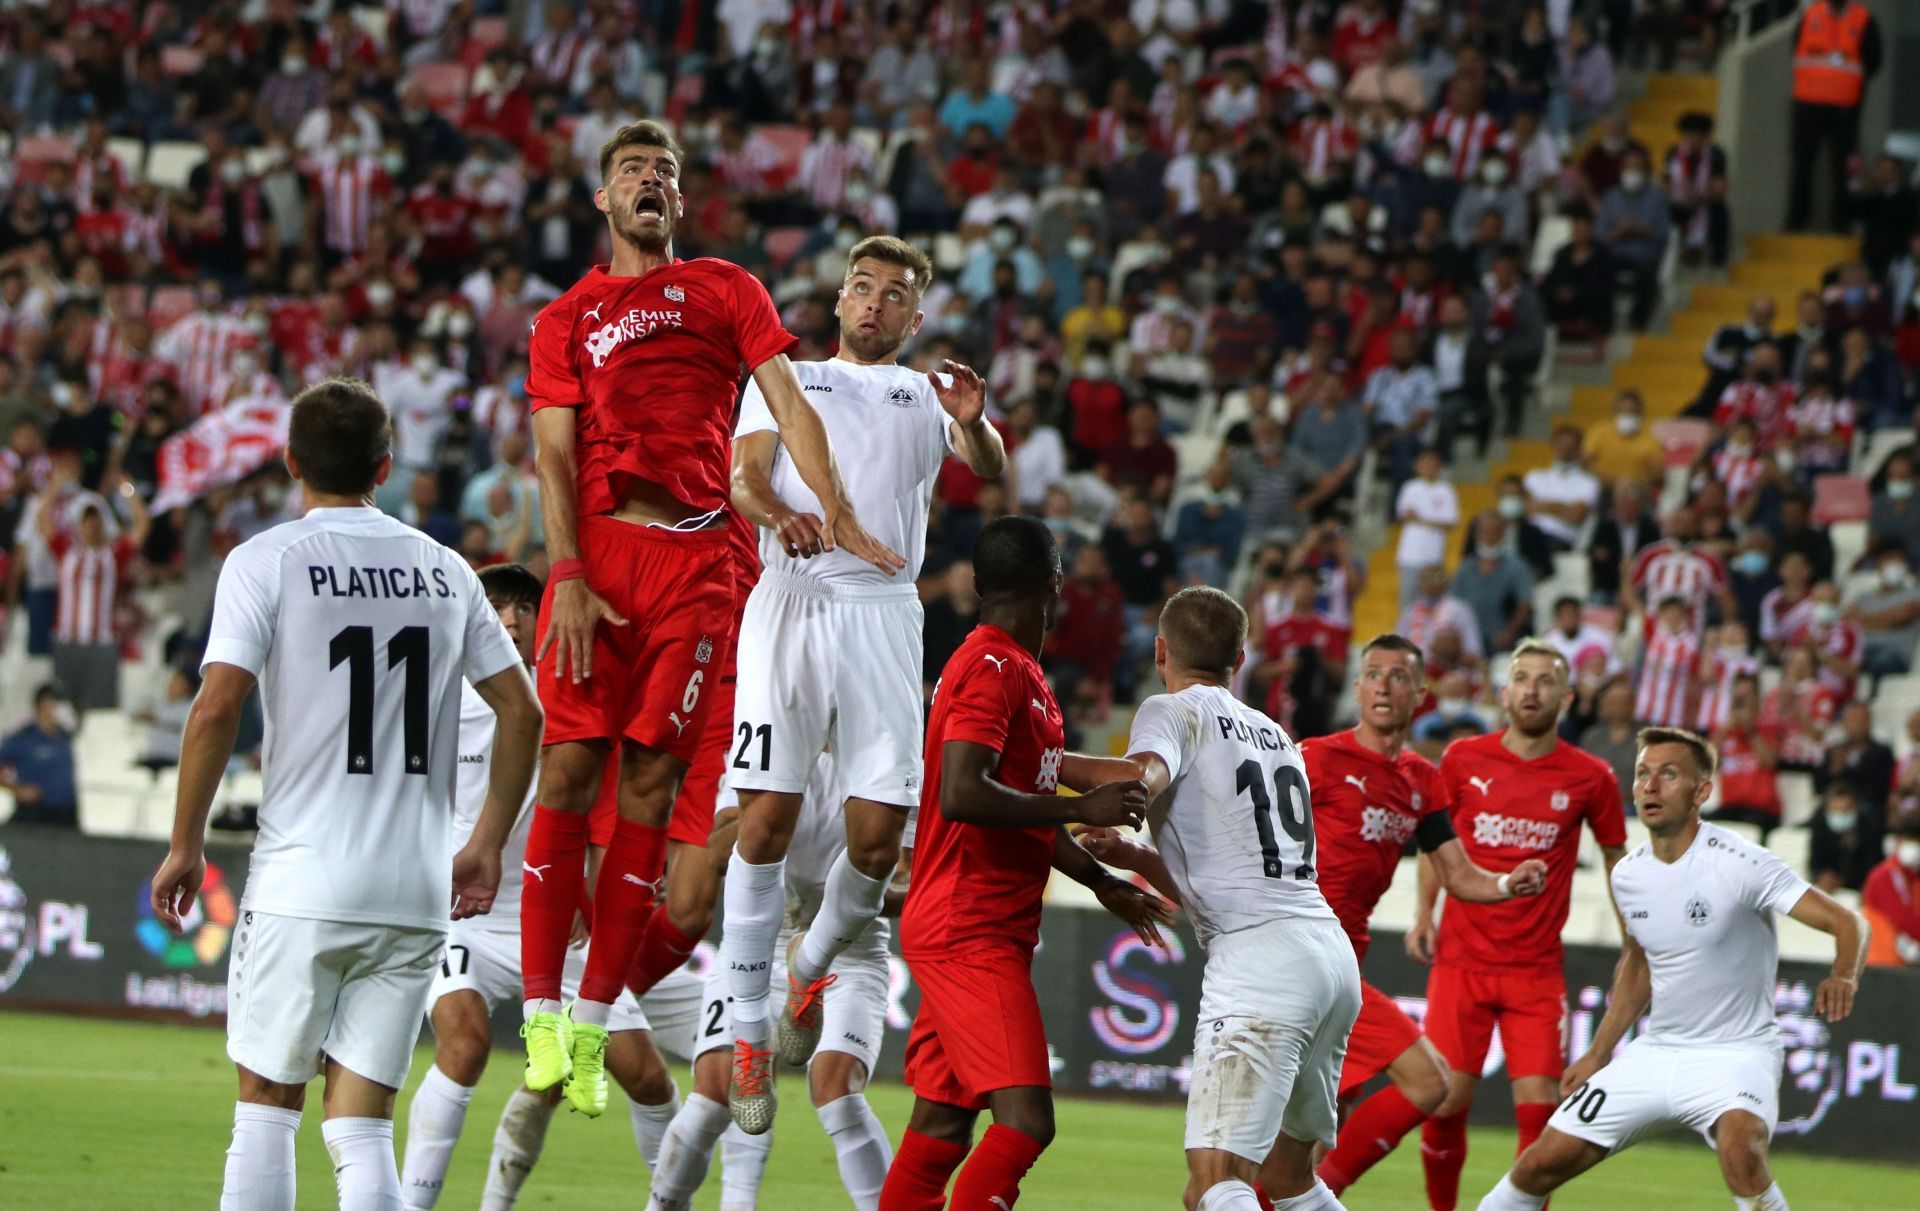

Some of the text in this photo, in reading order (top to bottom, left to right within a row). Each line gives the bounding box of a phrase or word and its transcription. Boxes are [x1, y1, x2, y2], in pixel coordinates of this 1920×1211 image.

[804, 385, 832, 393] JAKO
[308, 565, 457, 598] PLATICA S.
[329, 625, 430, 775] 11
[682, 669, 704, 714] 6
[458, 754, 484, 763] JAKO
[733, 721, 773, 771] 21
[1236, 759, 1315, 880] 19
[38, 901, 104, 960] PL
[730, 961, 767, 972] JAKO
[843, 1032, 869, 1049] JAKO
[1845, 1042, 1917, 1101] PL
